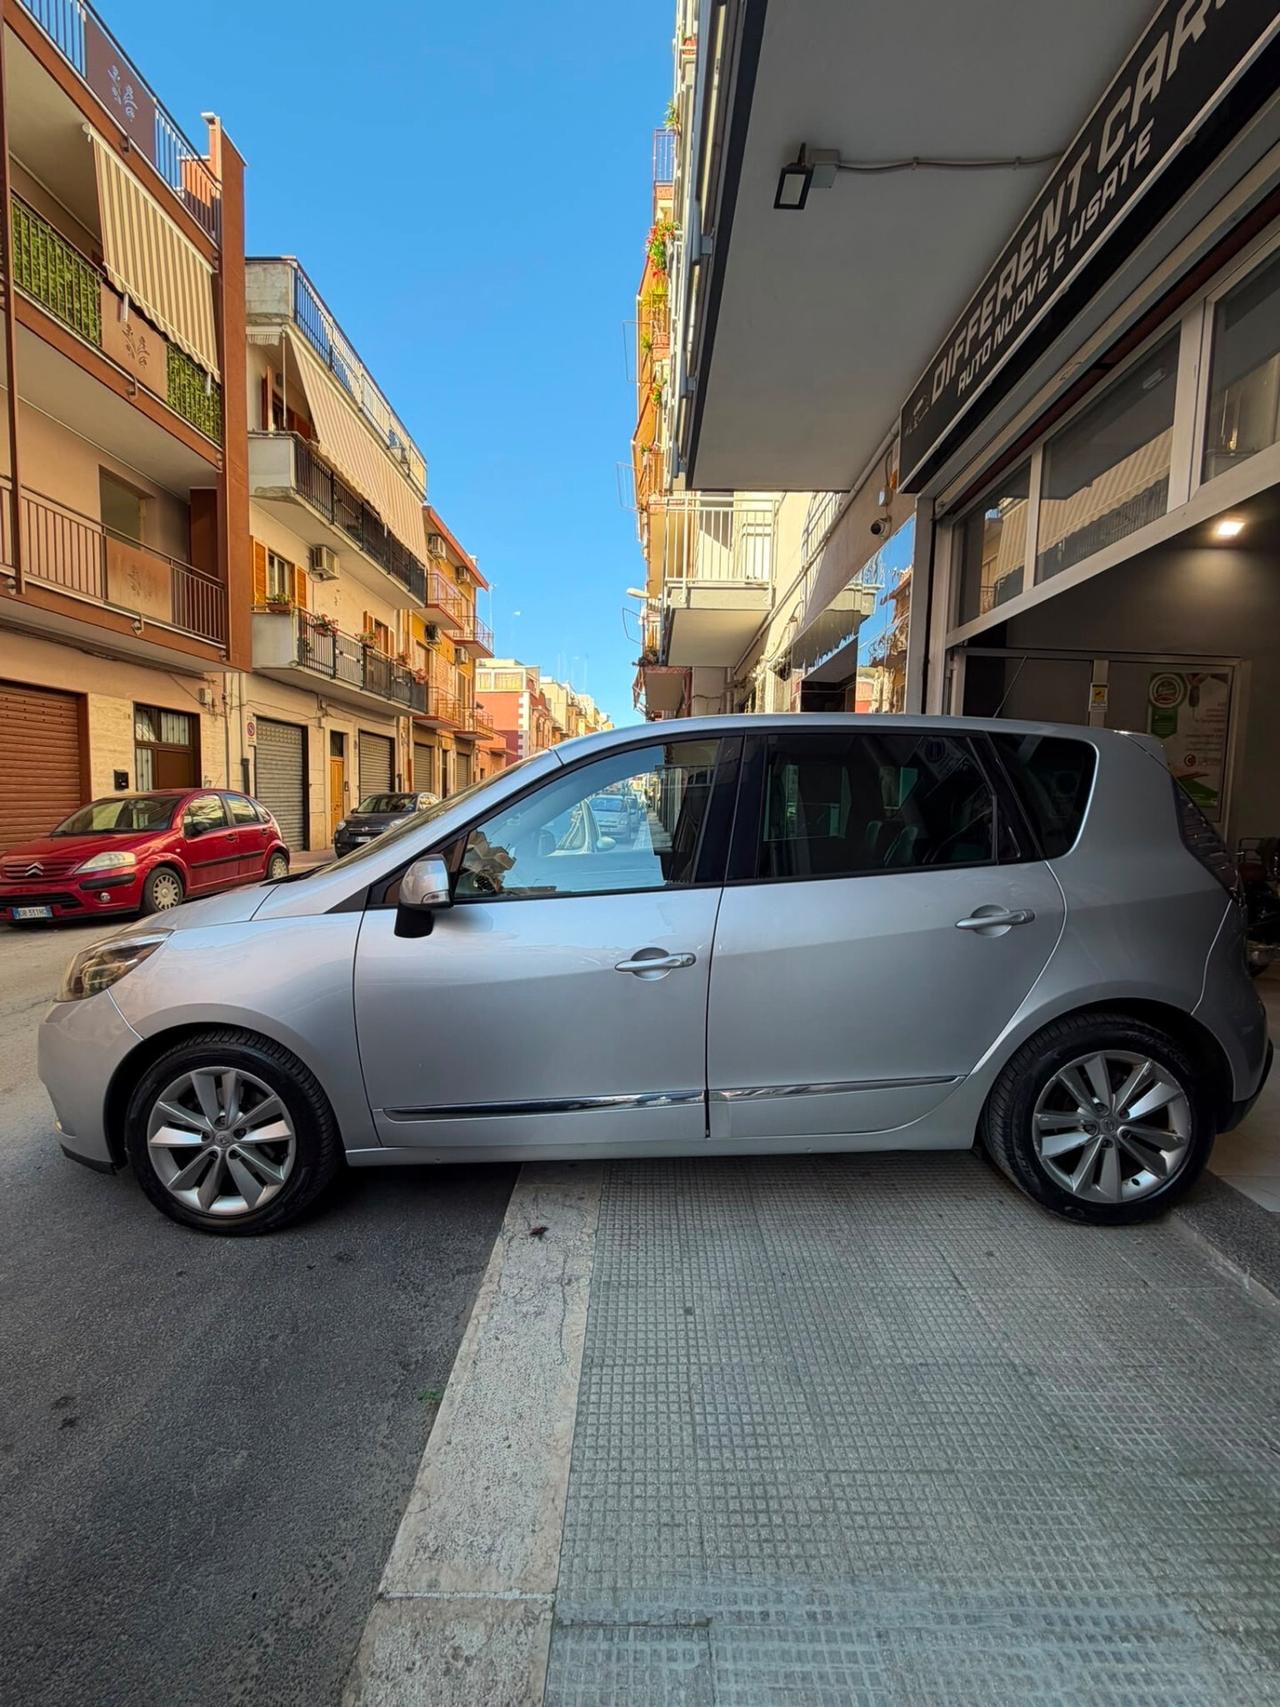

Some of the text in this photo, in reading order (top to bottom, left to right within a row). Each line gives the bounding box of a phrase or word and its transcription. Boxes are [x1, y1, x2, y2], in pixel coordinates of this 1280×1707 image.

[931, 0, 1227, 406] DIFFERENT CAR
[957, 118, 1156, 397] AUTO NUOVE E USATE
